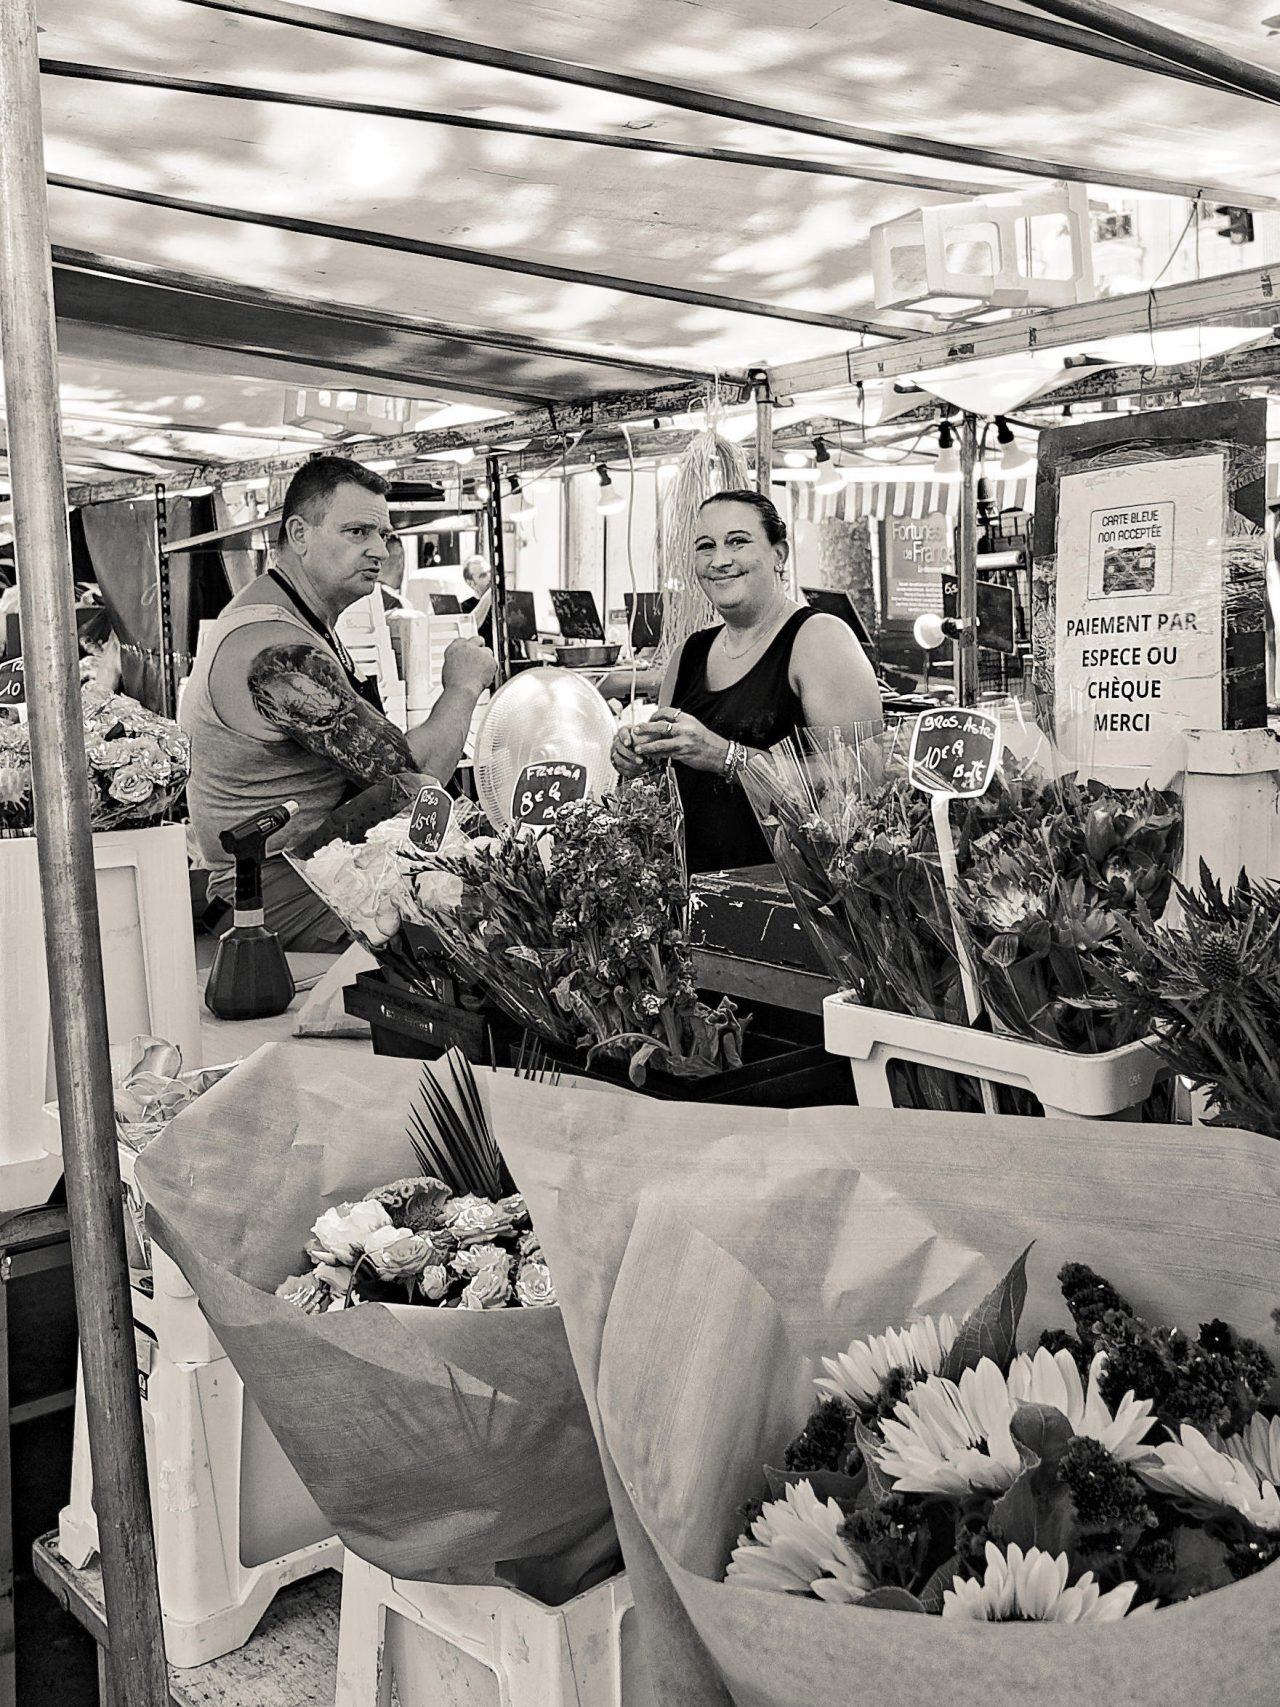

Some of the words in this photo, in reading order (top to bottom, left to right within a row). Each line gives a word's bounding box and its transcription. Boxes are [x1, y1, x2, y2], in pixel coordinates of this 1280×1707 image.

[1102, 513, 1128, 527] CARTE
[1131, 510, 1159, 524] BLEUE
[892, 521, 942, 540] Fortunes
[1118, 524, 1162, 541] ACCEPTÉE
[1067, 614, 1152, 637] PAIEMENT
[1157, 612, 1198, 632] PAR
[1082, 647, 1141, 667] ESPECE
[1146, 646, 1177, 665] OU
[1088, 676, 1161, 701] CHÈQUE
[1094, 713, 1151, 732] MERCI
